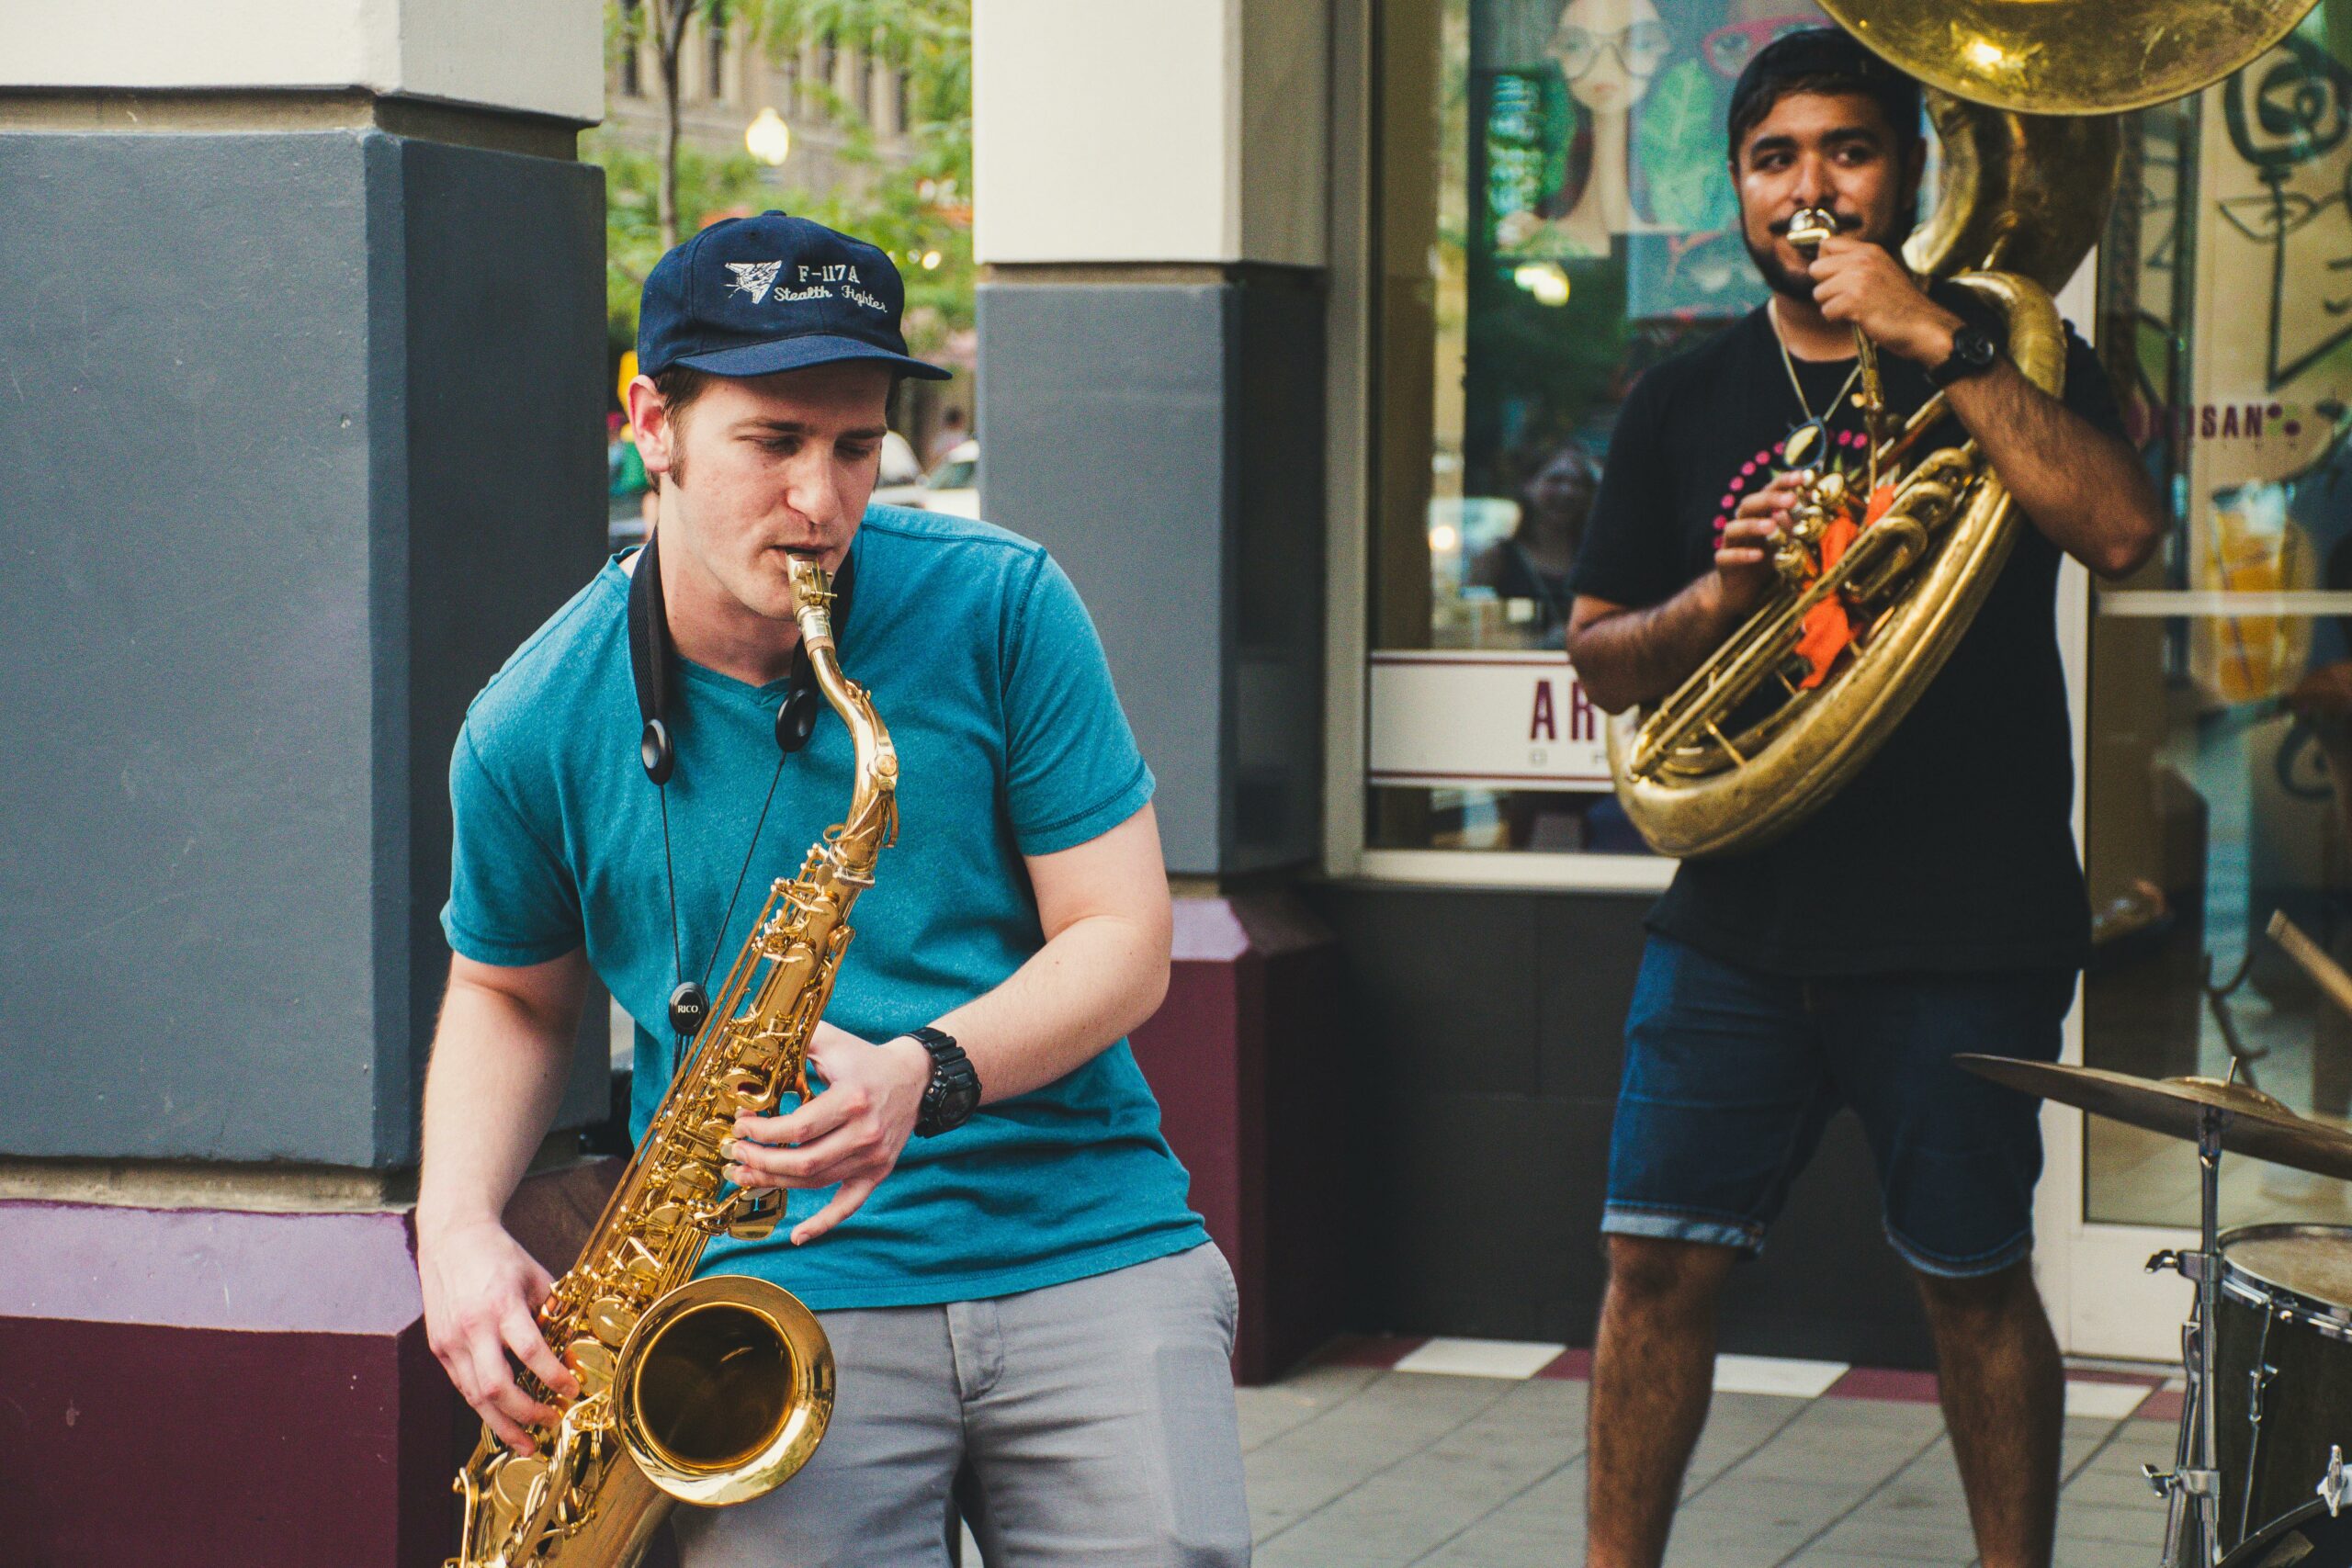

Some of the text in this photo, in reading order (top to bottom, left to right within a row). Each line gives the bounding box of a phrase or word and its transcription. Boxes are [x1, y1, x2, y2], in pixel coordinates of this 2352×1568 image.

[797, 264, 861, 285] F-117A
[774, 285, 888, 313] Stealth Fighter
[677, 1005, 699, 1014] RICO
